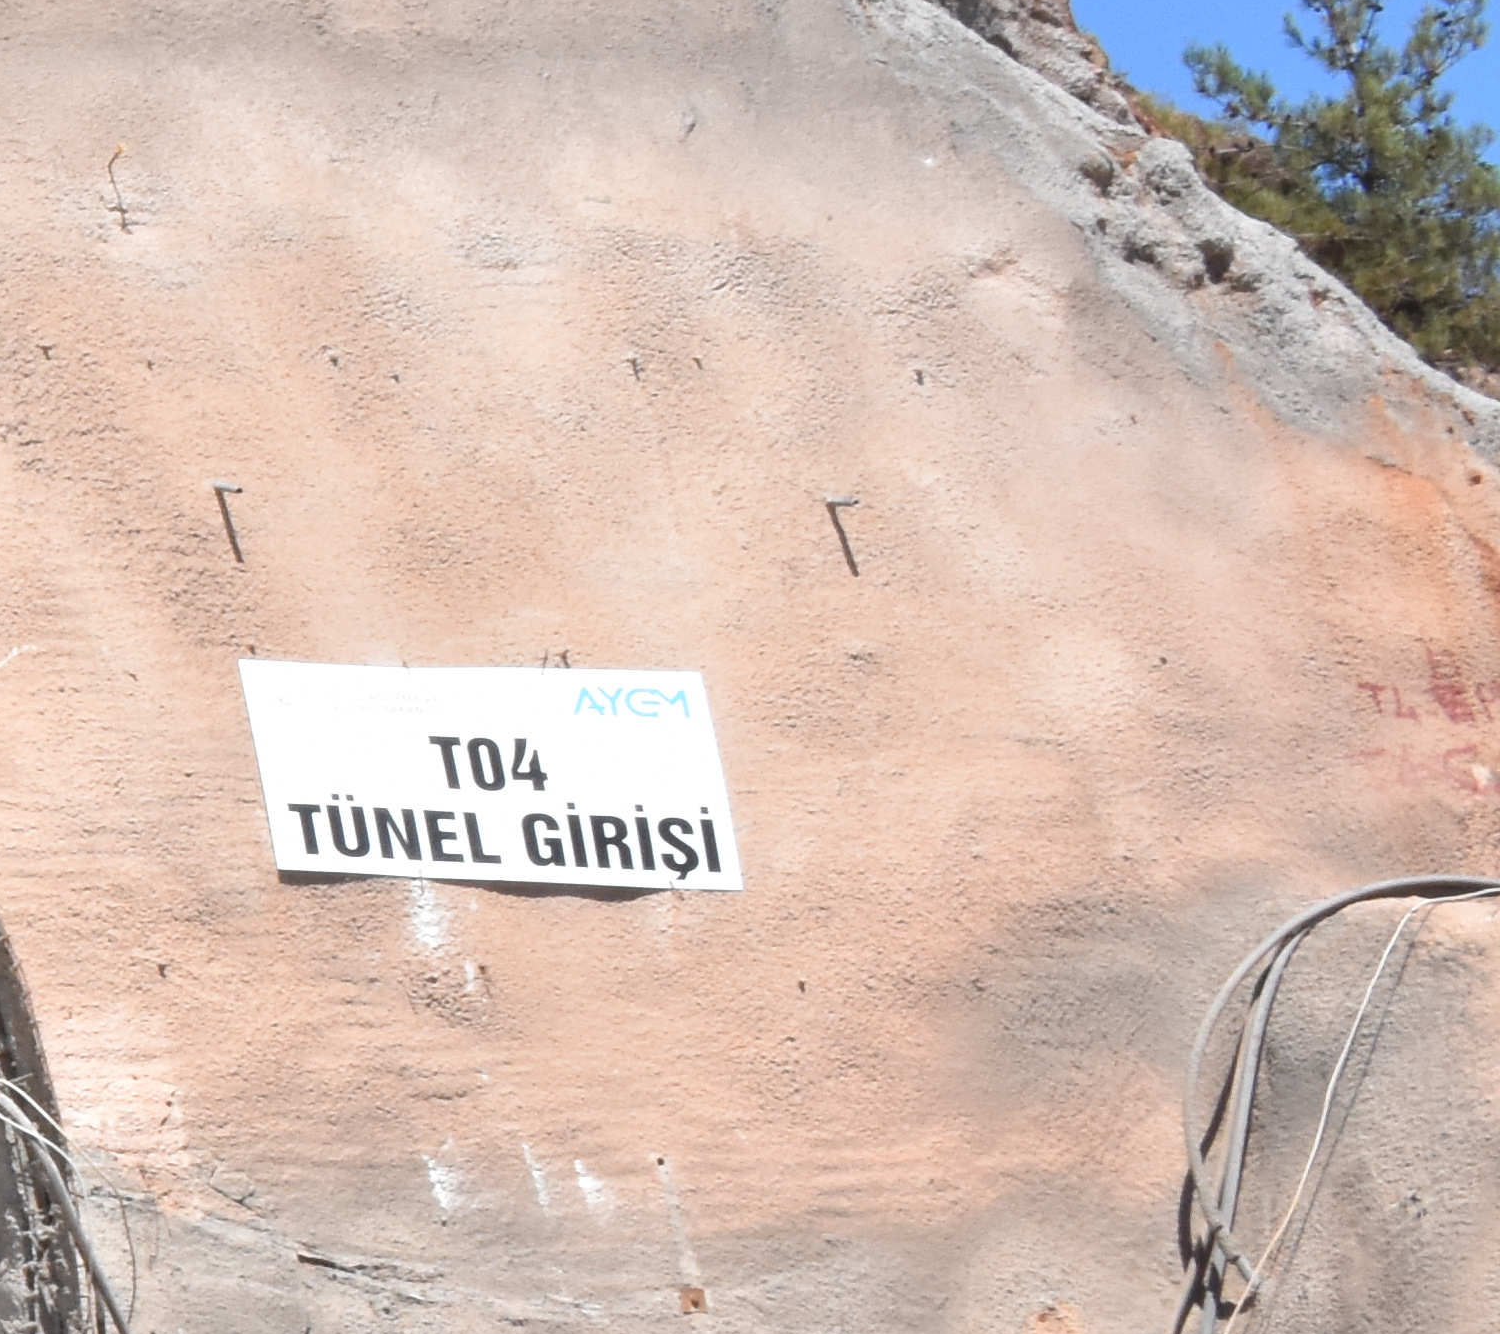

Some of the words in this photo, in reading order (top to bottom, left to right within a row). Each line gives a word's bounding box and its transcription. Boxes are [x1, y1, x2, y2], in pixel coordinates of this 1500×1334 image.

[429, 736, 548, 791] T04
[288, 794, 501, 864] TÜNEL
[521, 803, 722, 880] GİRİŞİ
